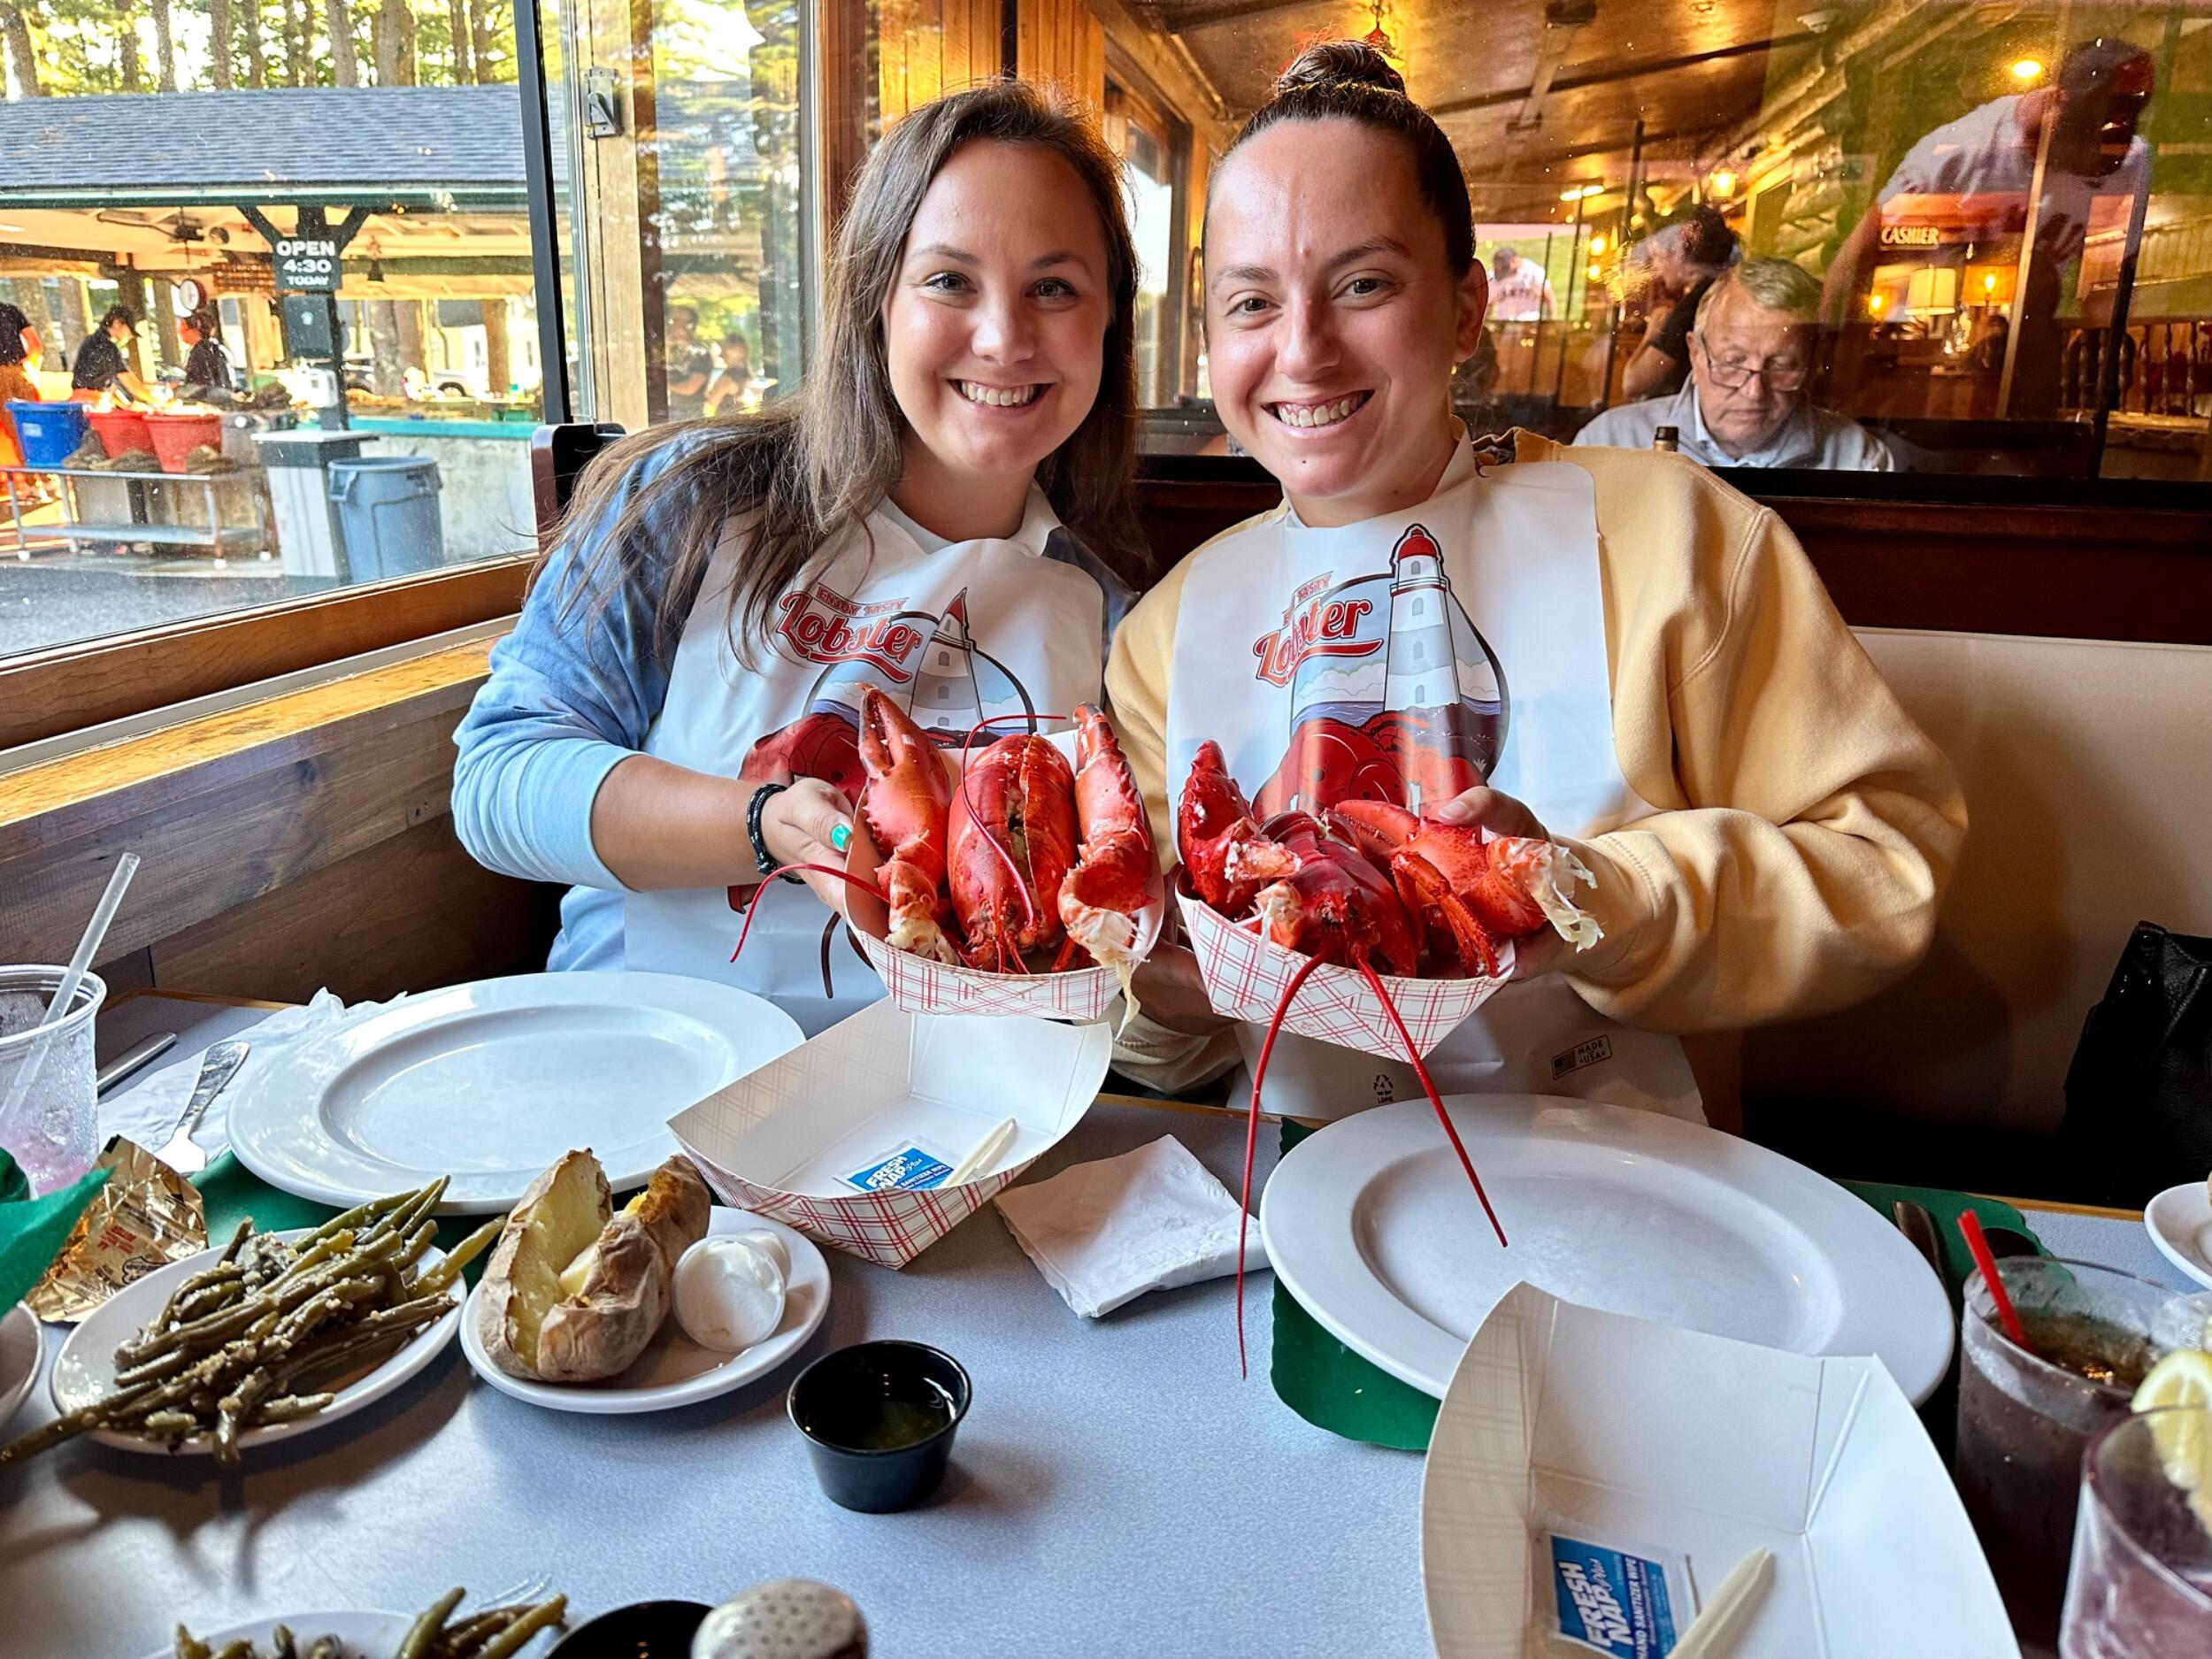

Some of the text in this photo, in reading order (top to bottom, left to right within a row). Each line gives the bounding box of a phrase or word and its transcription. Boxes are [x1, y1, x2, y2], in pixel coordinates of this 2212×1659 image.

[1881, 226, 1939, 245] CASHIER
[276, 240, 335, 257] OPEN
[283, 258, 332, 273] 4:30
[286, 274, 329, 286] TODAY
[817, 587, 862, 616] ENJOY
[776, 590, 924, 664] Lobster
[1578, 1040, 1603, 1055] MADE
[1584, 1052, 1601, 1063] USA
[865, 1156, 907, 1187] FRESH
[876, 1166, 906, 1188] NAP
[1624, 1556, 1640, 1579] WIPE
[1557, 1561, 1612, 1647] FRESH
[1590, 1584, 1635, 1646] NAP
[1629, 1579, 1646, 1629] SANITIZER
[1635, 1630, 1649, 1659] HAND
